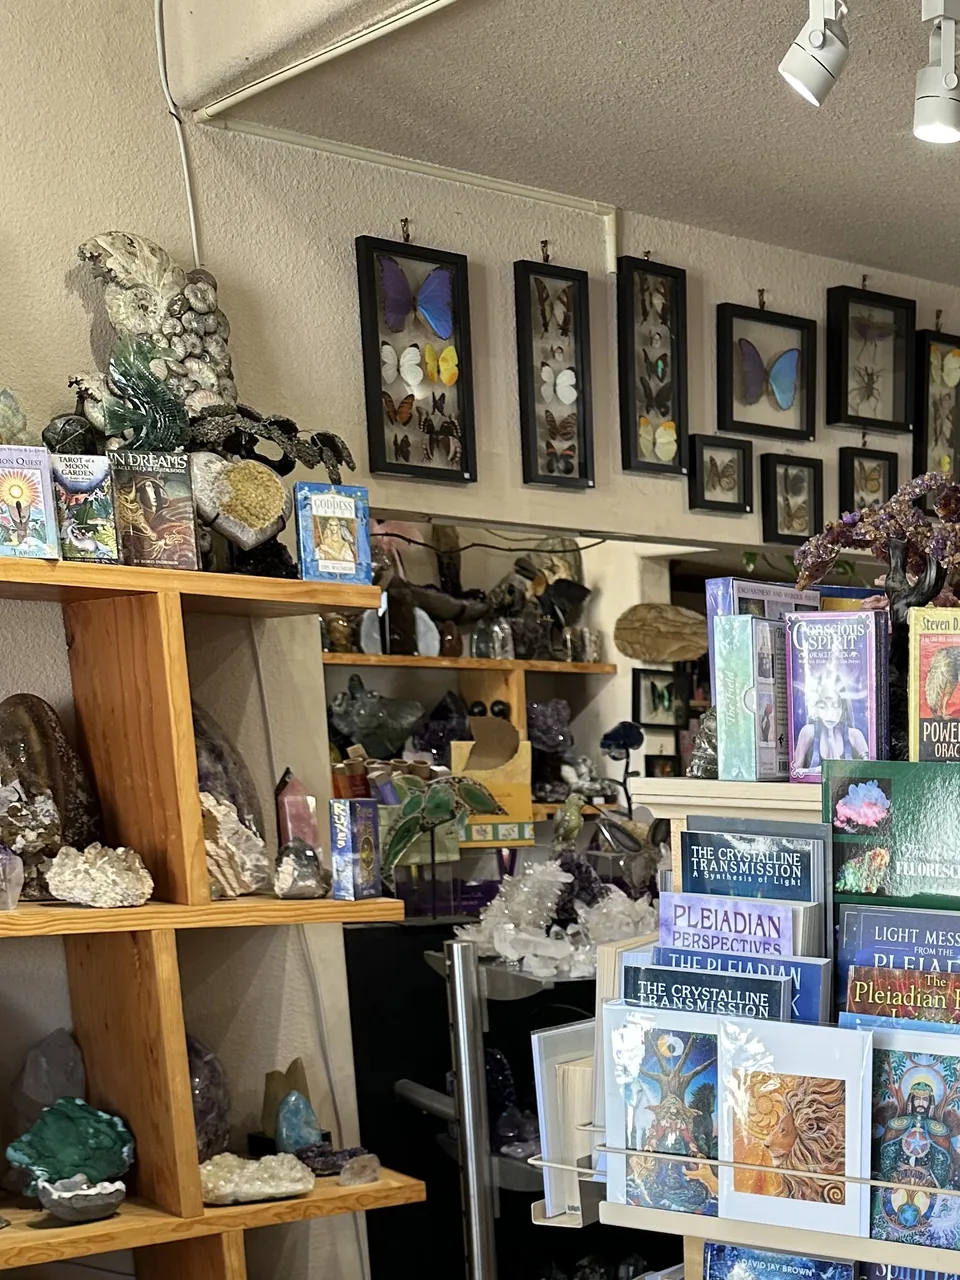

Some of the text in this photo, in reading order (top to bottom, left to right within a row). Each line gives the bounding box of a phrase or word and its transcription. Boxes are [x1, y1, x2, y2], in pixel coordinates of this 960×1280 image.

[58, 456, 83, 464] TAROT
[64, 462, 90, 470] MOON
[128, 453, 187, 468] DREAMS
[61, 469, 95, 477] GARDEN
[313, 499, 354, 511] GODDESS
[922, 617, 950, 631] Steven
[953, 618, 960, 631] D.
[809, 635, 858, 651] SPIRIT
[726, 703, 736, 726] The
[691, 845, 801, 866] THE CRYSTALLINE
[691, 857, 801, 878] TRANSMISSION
[692, 870, 699, 878] A
[704, 871, 752, 883] Synthesis
[773, 877, 801, 887] Light
[673, 903, 781, 939] PLEIADIAN
[672, 930, 782, 956] PERSPECTIVES
[874, 926, 919, 943] LIGHT
[914, 945, 954, 957] FROM THE
[925, 974, 947, 987] The
[637, 980, 666, 996] THE
[671, 984, 769, 1007] CRYSTALLINE
[854, 981, 946, 1011] Pleiadian
[637, 992, 769, 1019] TRANSMISSION
[741, 1258, 814, 1278] DAVID JAY BROWN
